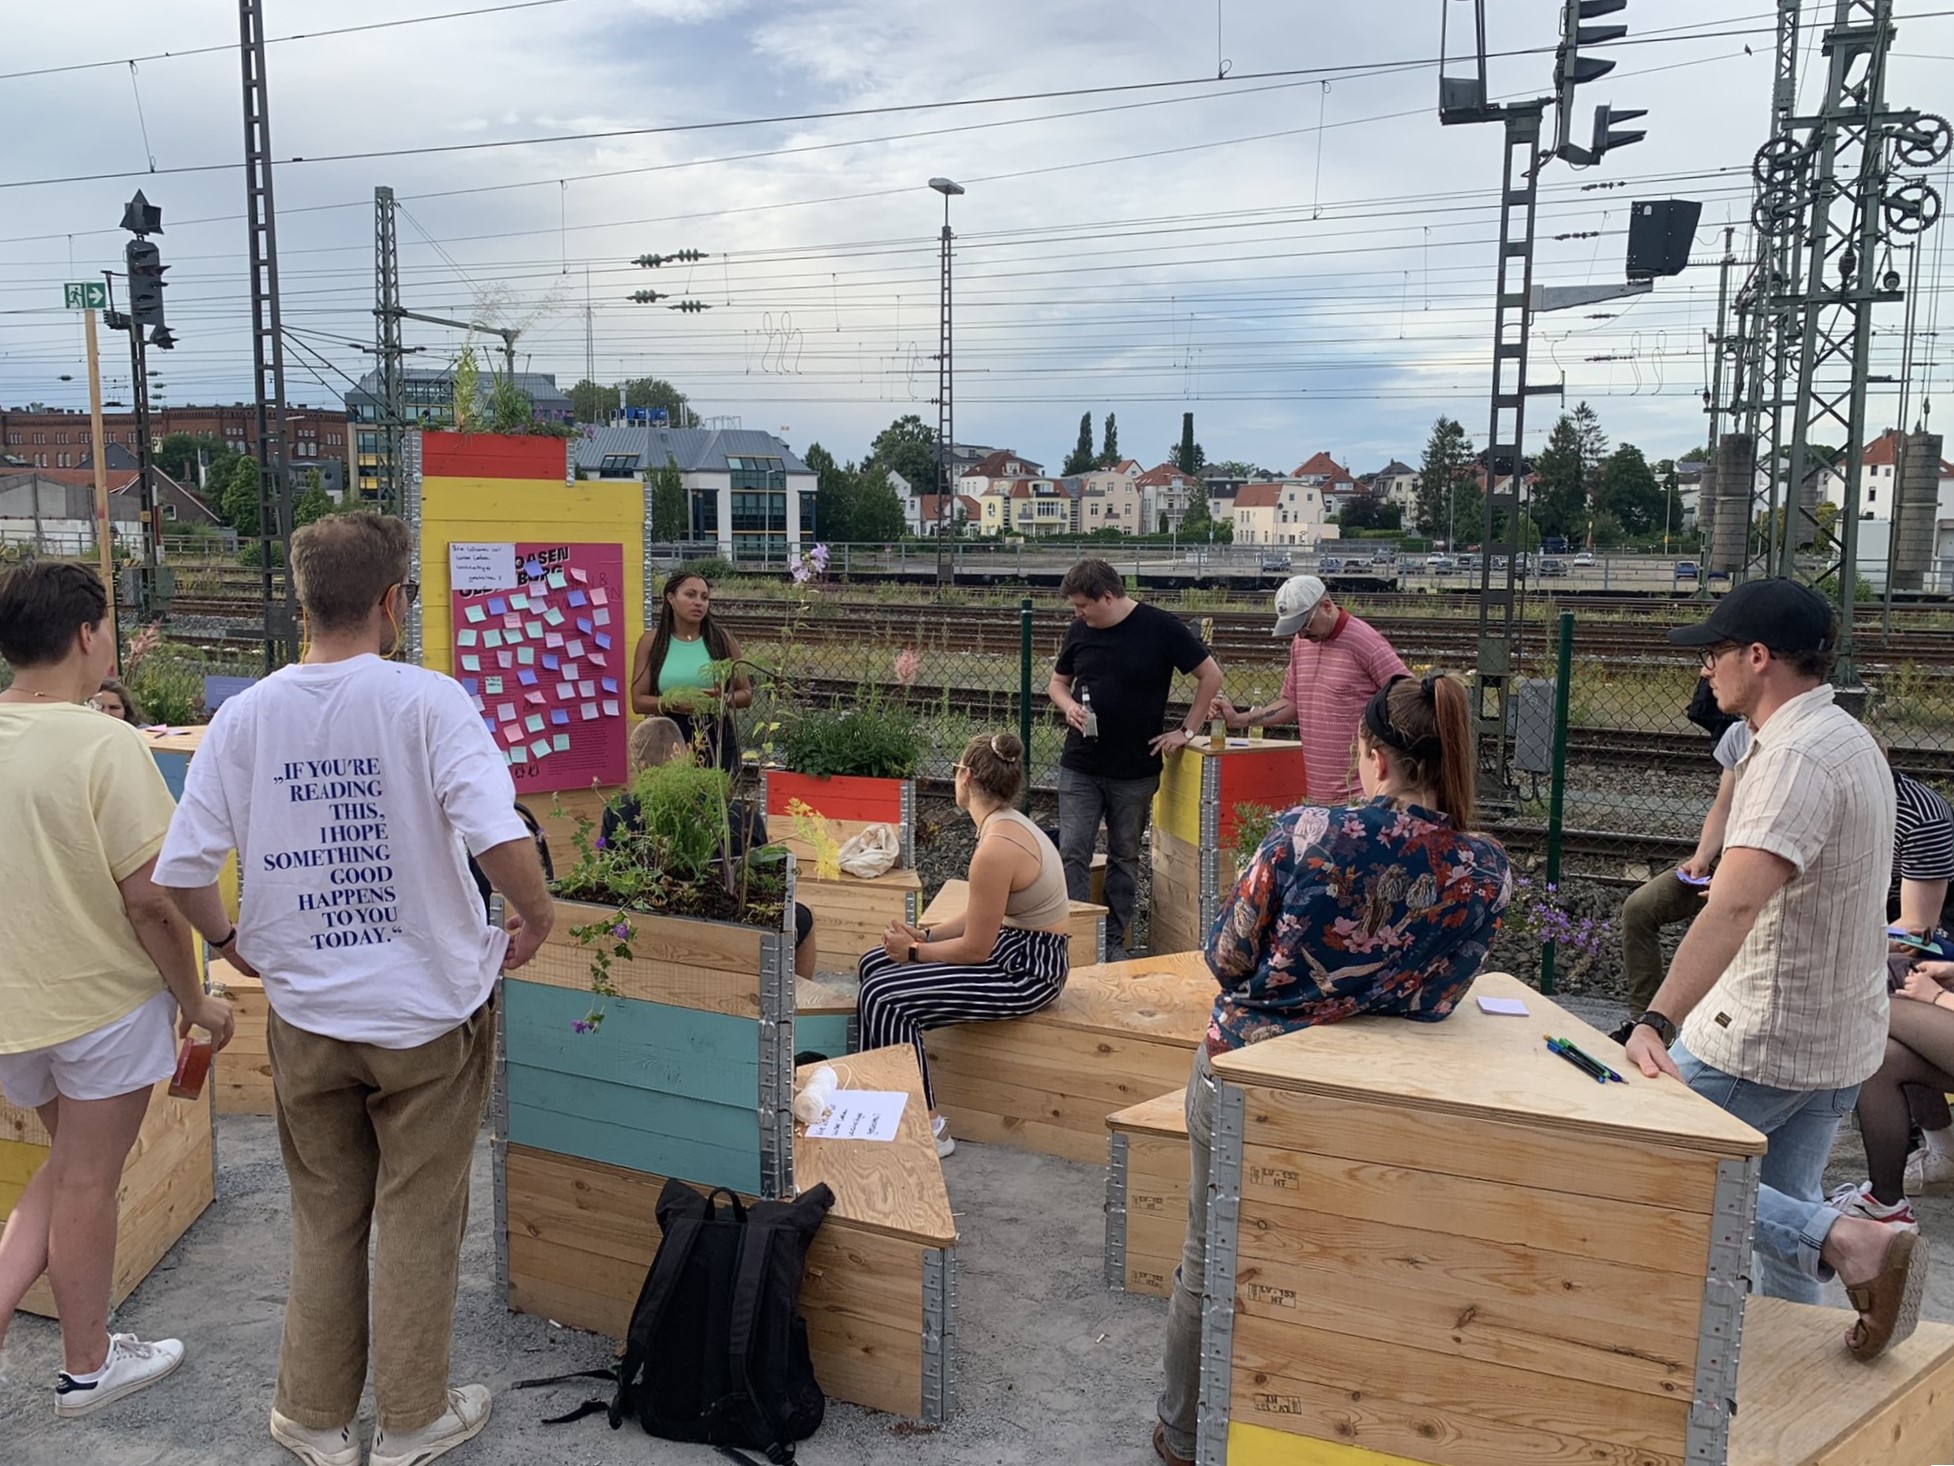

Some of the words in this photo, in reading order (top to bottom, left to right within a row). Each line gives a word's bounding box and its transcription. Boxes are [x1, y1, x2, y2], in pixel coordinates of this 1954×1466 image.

[290, 780, 383, 802] READING
[329, 803, 385, 821] THIS,
[331, 823, 389, 842] HOPE
[264, 844, 391, 871] SOMETHING
[330, 866, 393, 885] GOOD
[298, 886, 396, 911] HAPPENS
[322, 910, 353, 928] TO
[355, 907, 398, 923] YOU
